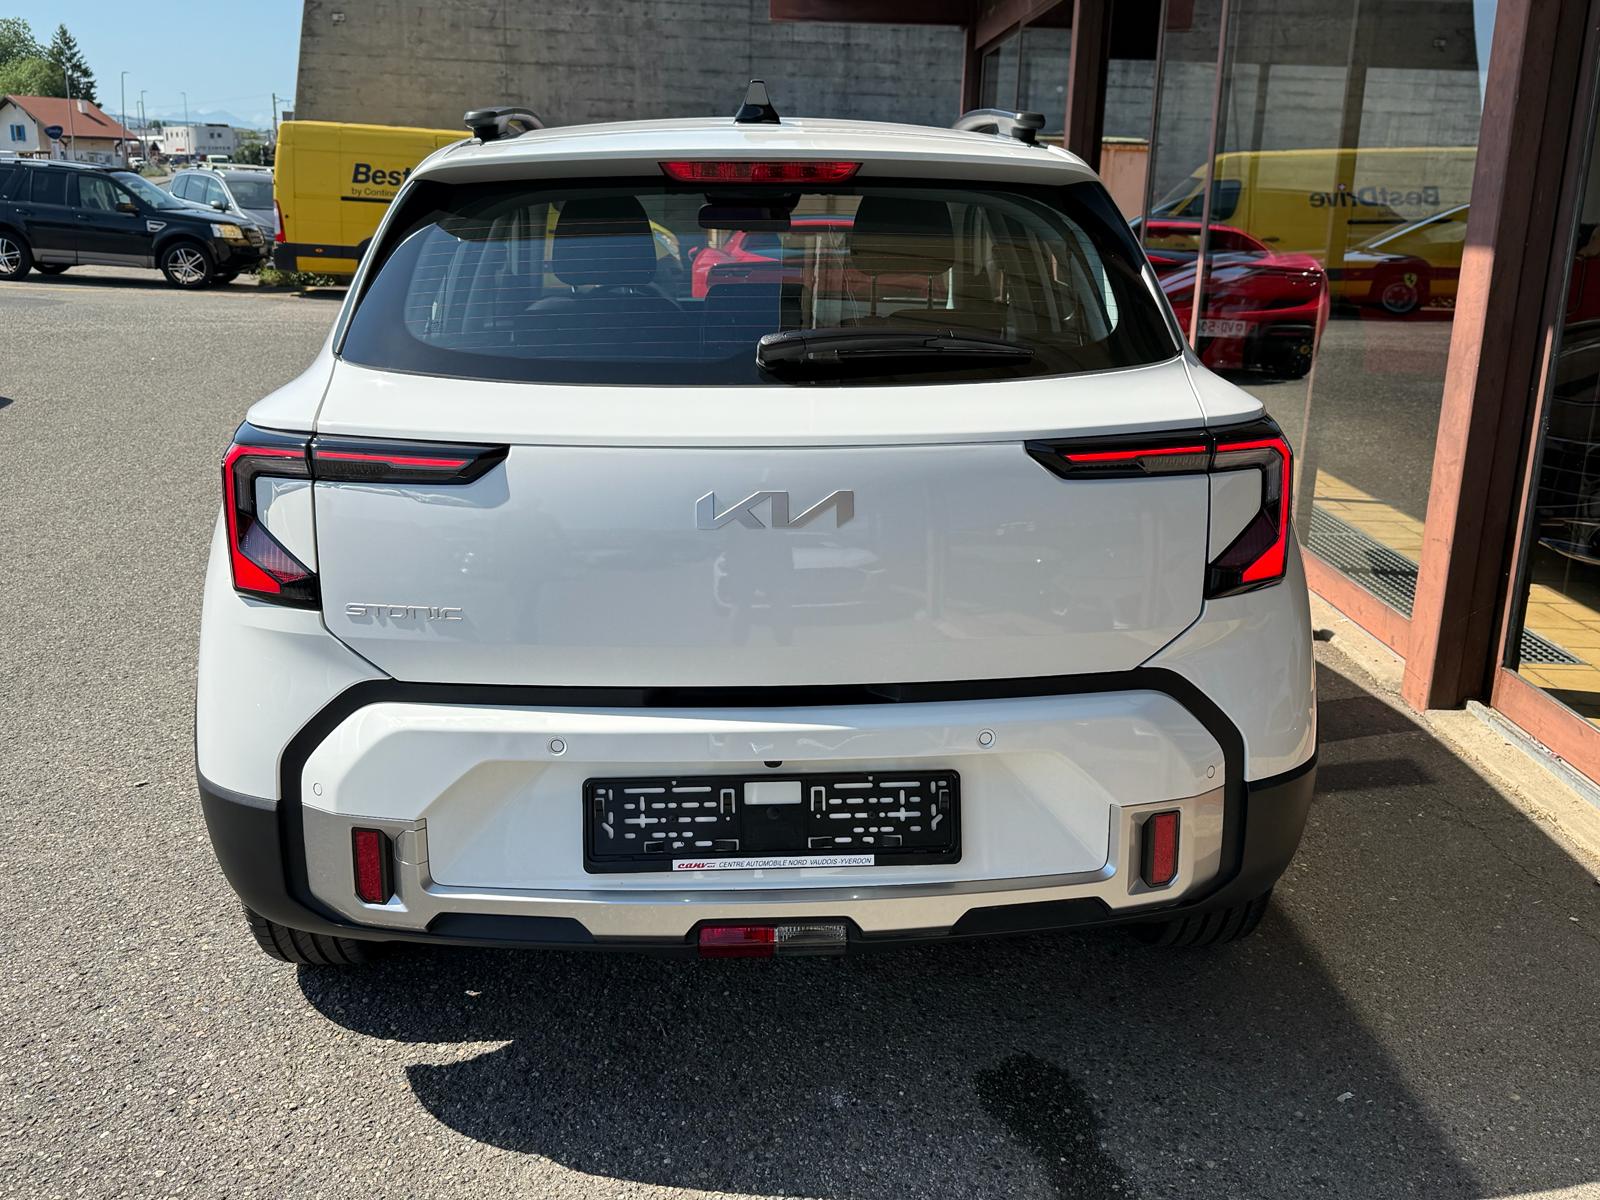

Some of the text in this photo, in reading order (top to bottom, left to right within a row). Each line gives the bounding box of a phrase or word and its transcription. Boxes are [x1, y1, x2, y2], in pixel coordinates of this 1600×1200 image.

[352, 188, 361, 196] by
[696, 490, 854, 529] KIA
[344, 602, 463, 621] STONIC
[744, 860, 787, 868] AUTOMOBILE
